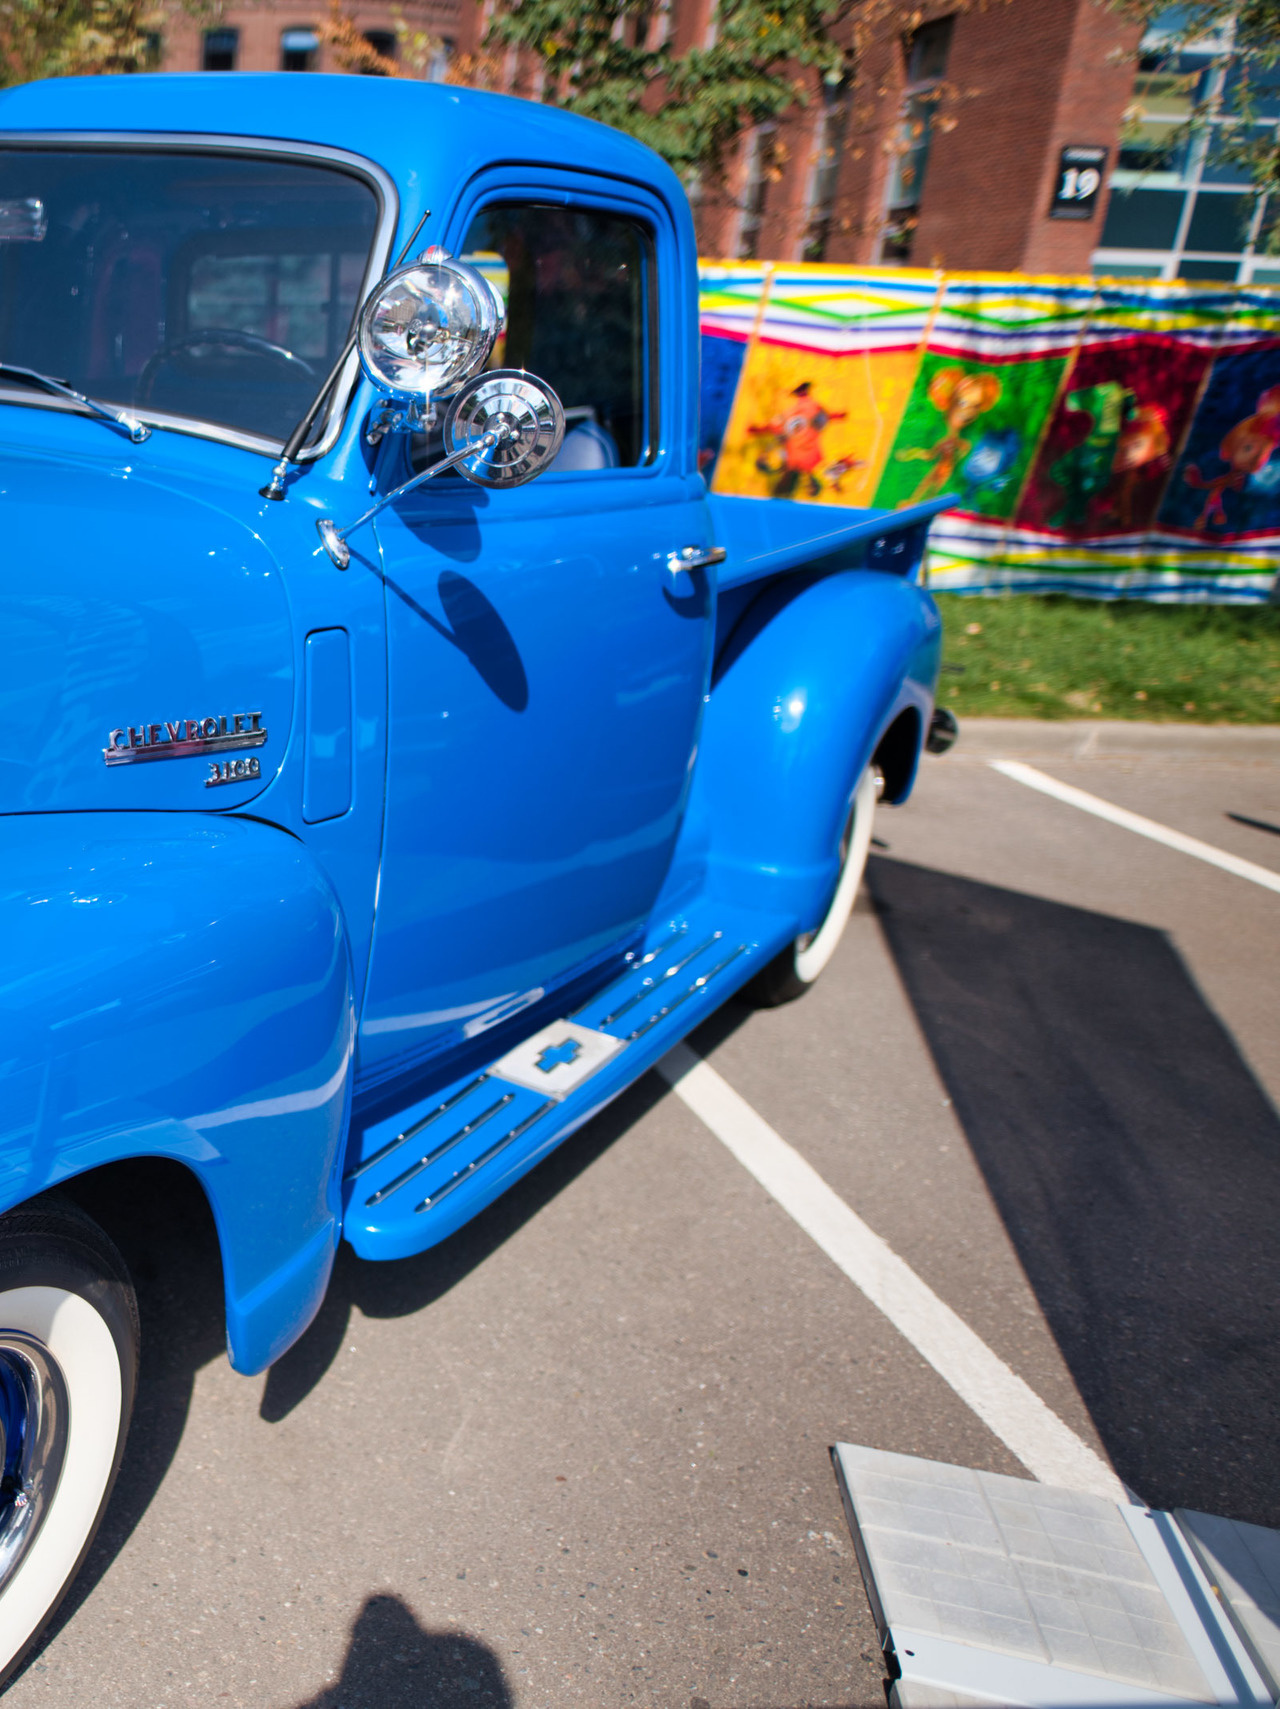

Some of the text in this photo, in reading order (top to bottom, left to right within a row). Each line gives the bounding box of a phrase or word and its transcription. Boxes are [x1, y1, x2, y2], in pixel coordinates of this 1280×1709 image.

[1058, 167, 1101, 201] 19
[108, 711, 263, 751] CHEVROLET
[208, 757, 261, 784] 3100
